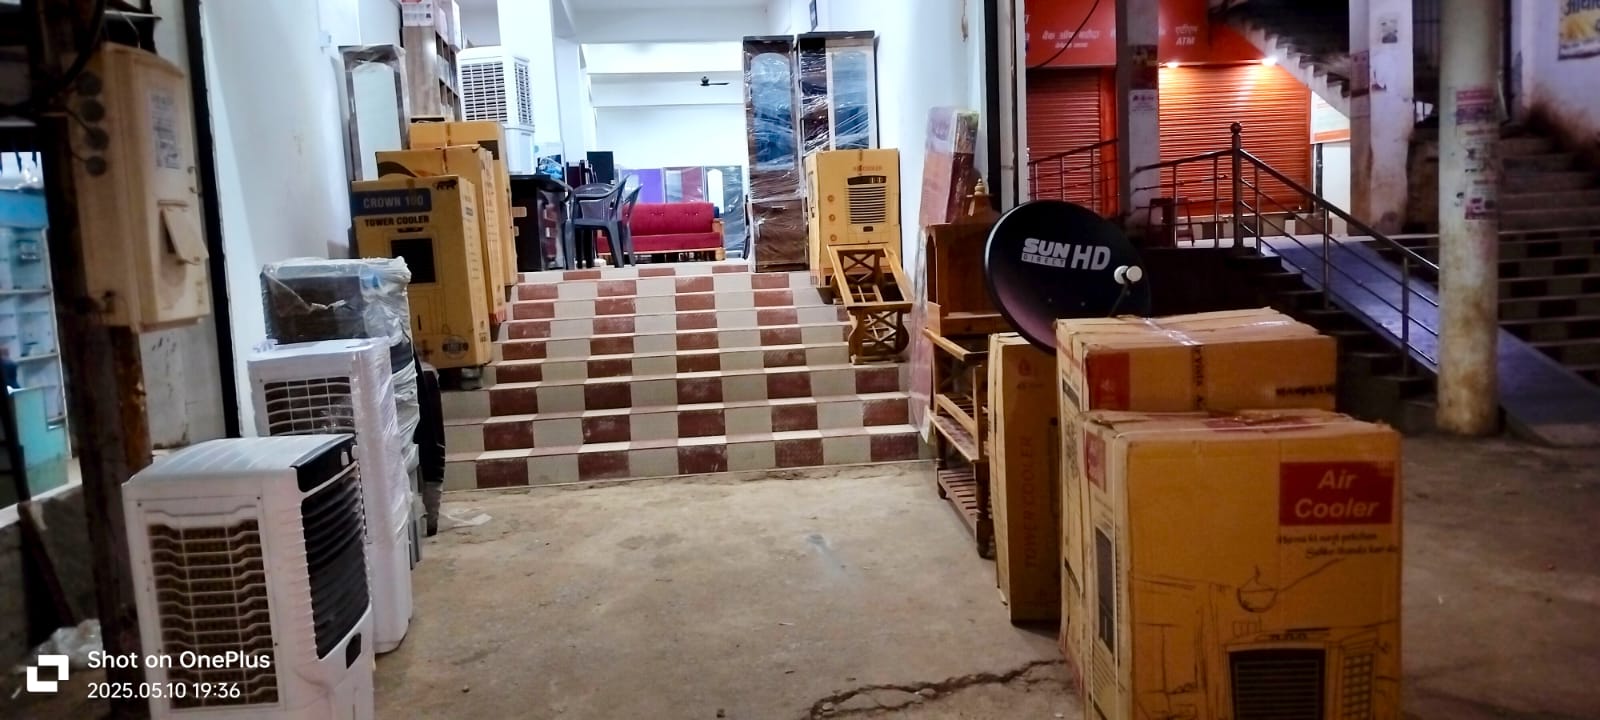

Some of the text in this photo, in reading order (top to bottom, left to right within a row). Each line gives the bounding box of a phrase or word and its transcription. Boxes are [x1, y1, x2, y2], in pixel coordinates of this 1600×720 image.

[1175, 36, 1196, 46] ATM
[363, 196, 401, 209] CROWN
[365, 215, 429, 227] TOWER COOLER
[1022, 238, 1111, 270] SUN HD
[1022, 253, 1065, 267] DIRECT
[1317, 469, 1358, 489] Air
[1019, 436, 1038, 569] TOWER COOLER
[1295, 498, 1379, 518] Cooler
